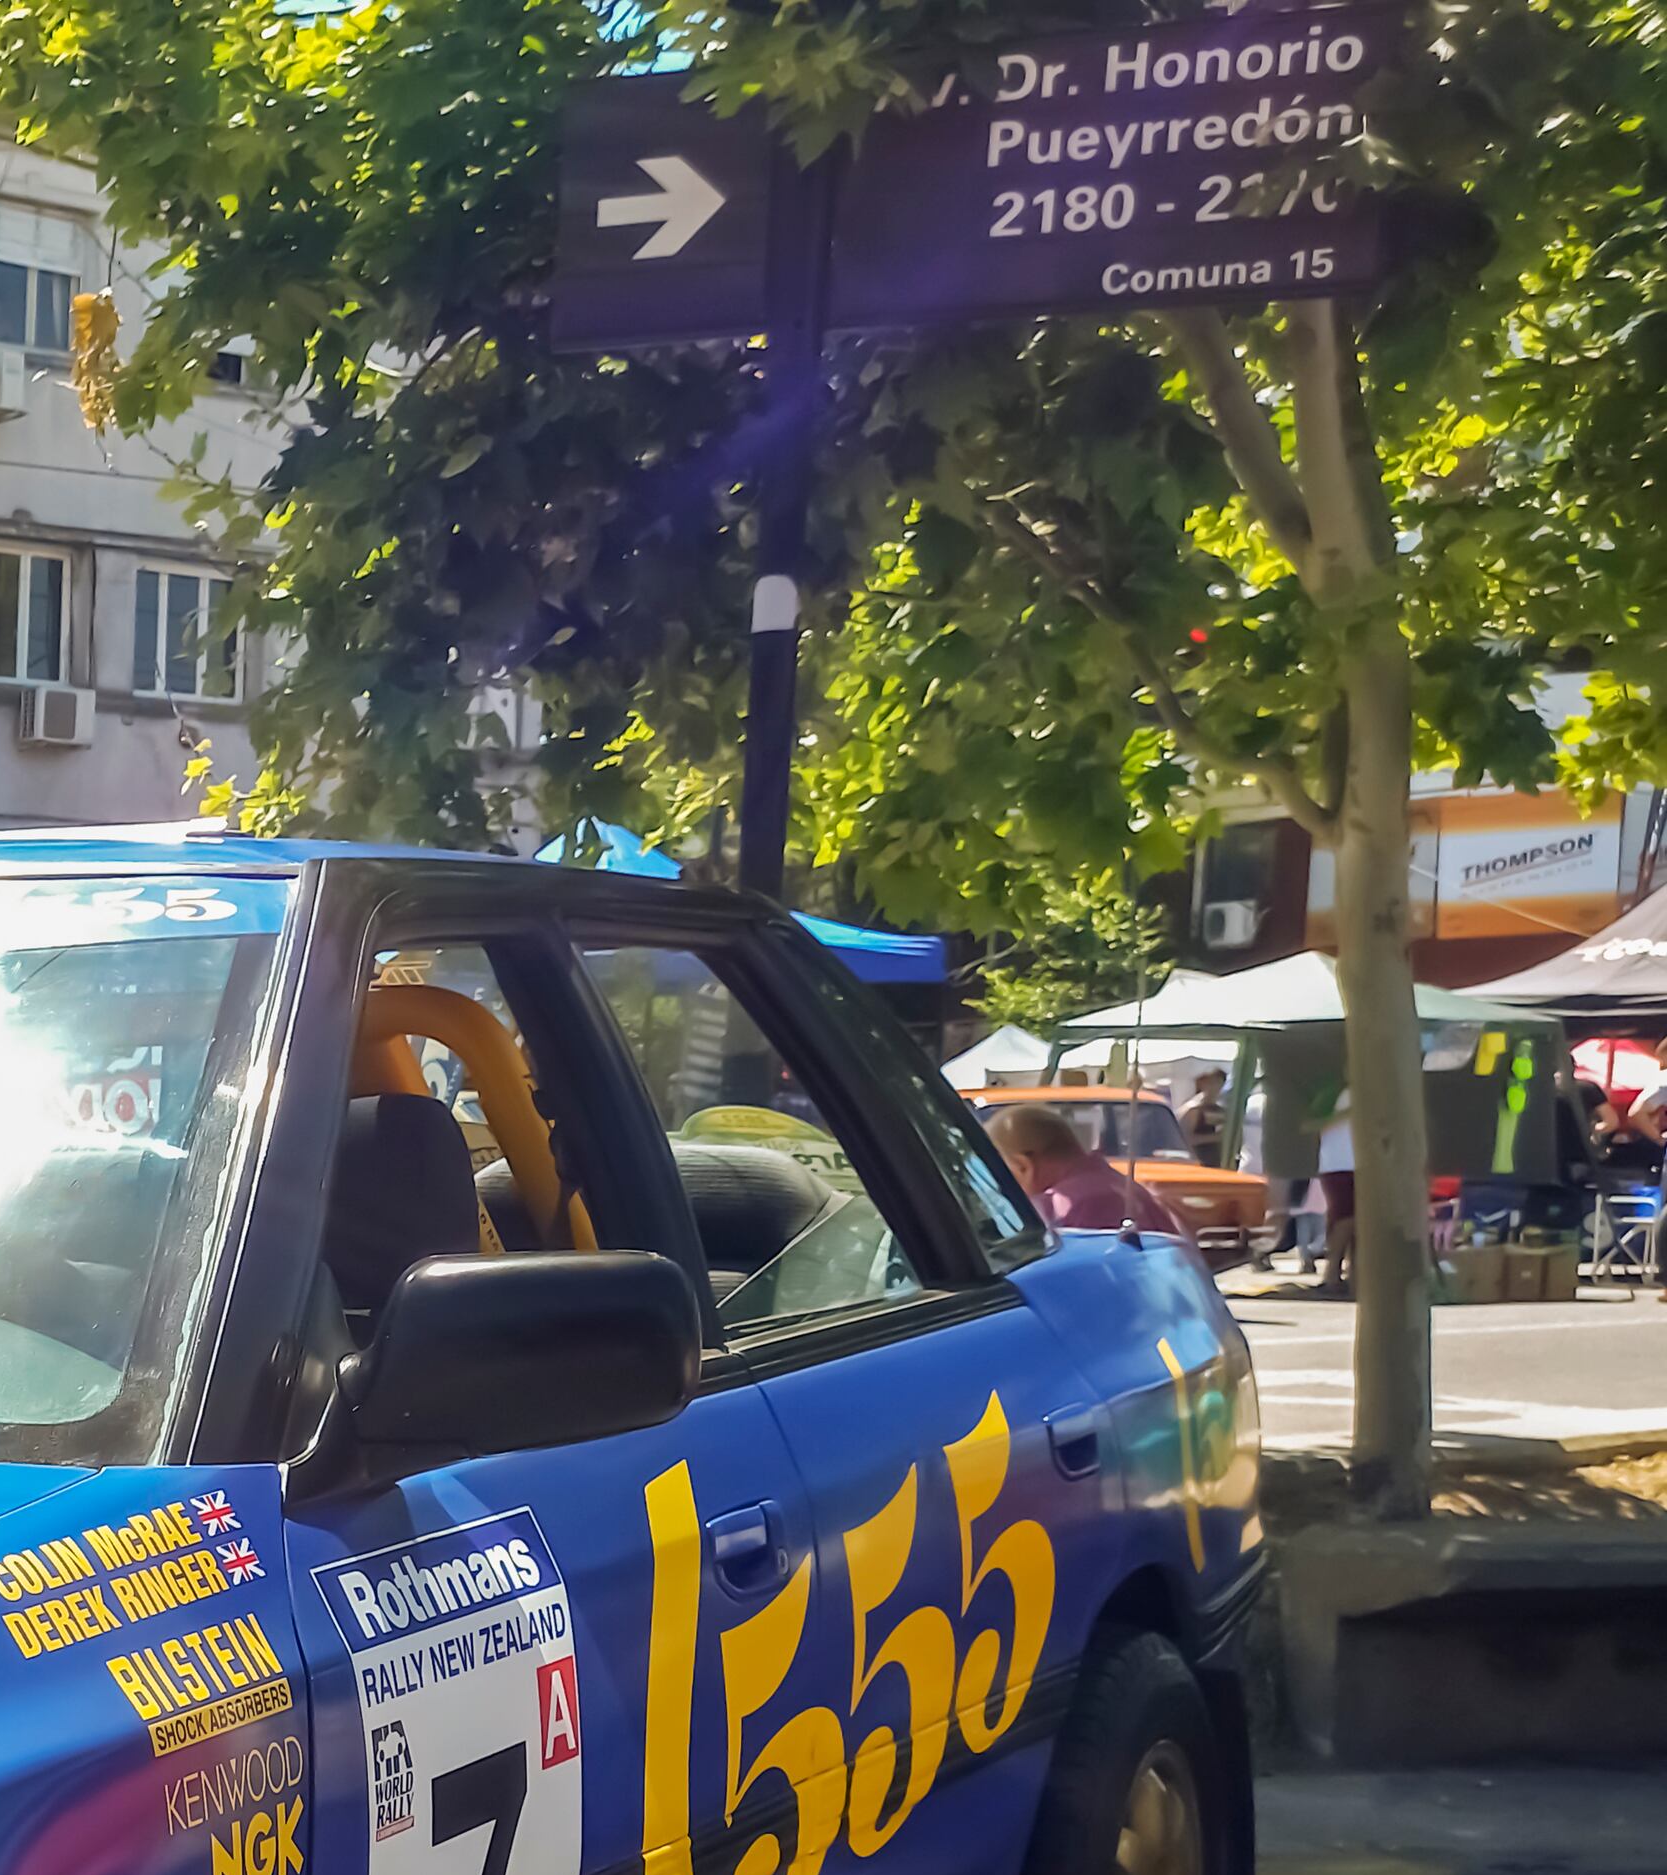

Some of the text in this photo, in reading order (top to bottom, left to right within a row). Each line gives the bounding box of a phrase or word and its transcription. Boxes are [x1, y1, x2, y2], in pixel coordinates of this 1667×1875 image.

[994, 53, 1079, 102] Dr.
[1103, 25, 1364, 93] Honorio
[986, 95, 1356, 169] Pueyrredón
[988, 183, 1134, 237] 2180
[1101, 247, 1334, 296] Comuna 15
[1463, 833, 1595, 882] THOMPSON
[81, 1501, 204, 1572] McRAE
[2, 1549, 230, 1660] DEREK RINGER
[337, 1537, 541, 1641] Rothmans
[105, 1612, 285, 1722] BILSTEIN
[362, 1602, 566, 1708] RALLY NEW ZEALAND
[154, 1682, 289, 1752] SHOCK ABSORBERS
[545, 1669, 576, 1760] A
[164, 1735, 305, 1836] KENWOOD
[375, 1771, 414, 1805] WORLD
[377, 1792, 414, 1829] RALLY
